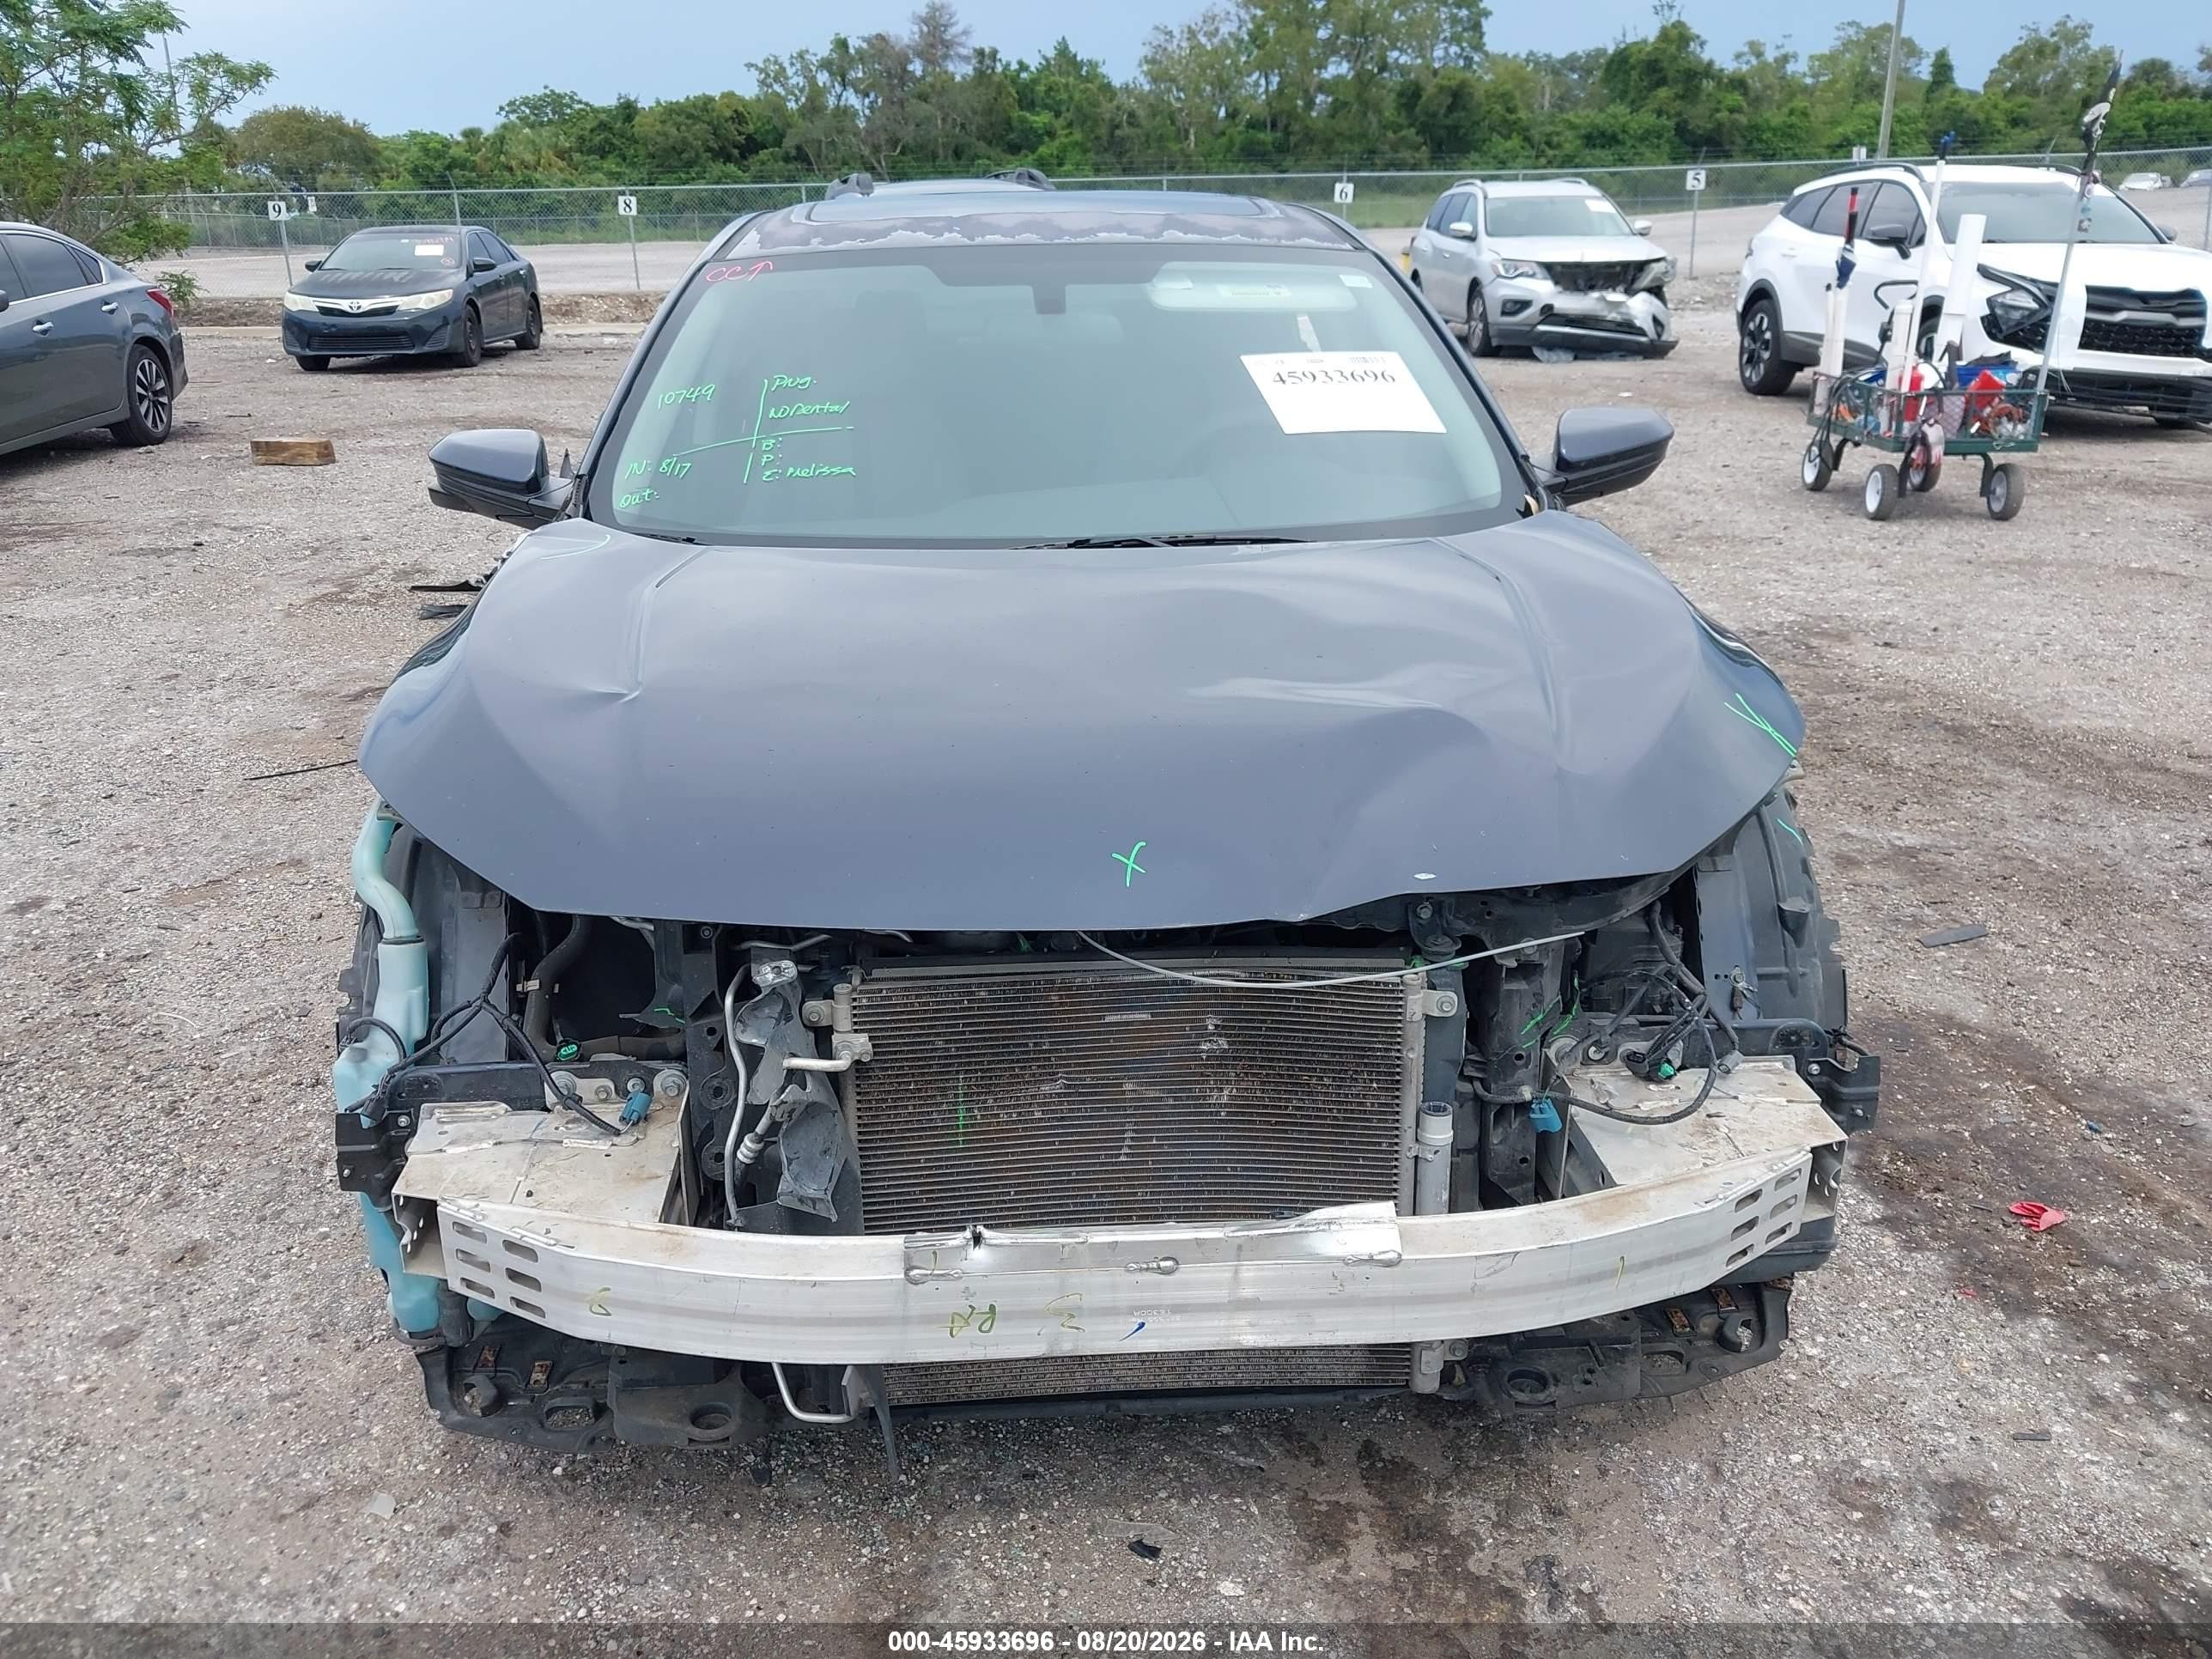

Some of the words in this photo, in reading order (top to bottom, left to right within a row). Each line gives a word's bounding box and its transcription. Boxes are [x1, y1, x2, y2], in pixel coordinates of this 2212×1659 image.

[1691, 172, 1702, 188] 5
[1339, 185, 1348, 201] 6
[272, 203, 282, 218] 9
[623, 198, 632, 213] 8
[1272, 369, 1396, 385] 45933696
[658, 384, 715, 410] 10749
[659, 456, 692, 479] 8/17
[761, 453, 783, 466] P:
